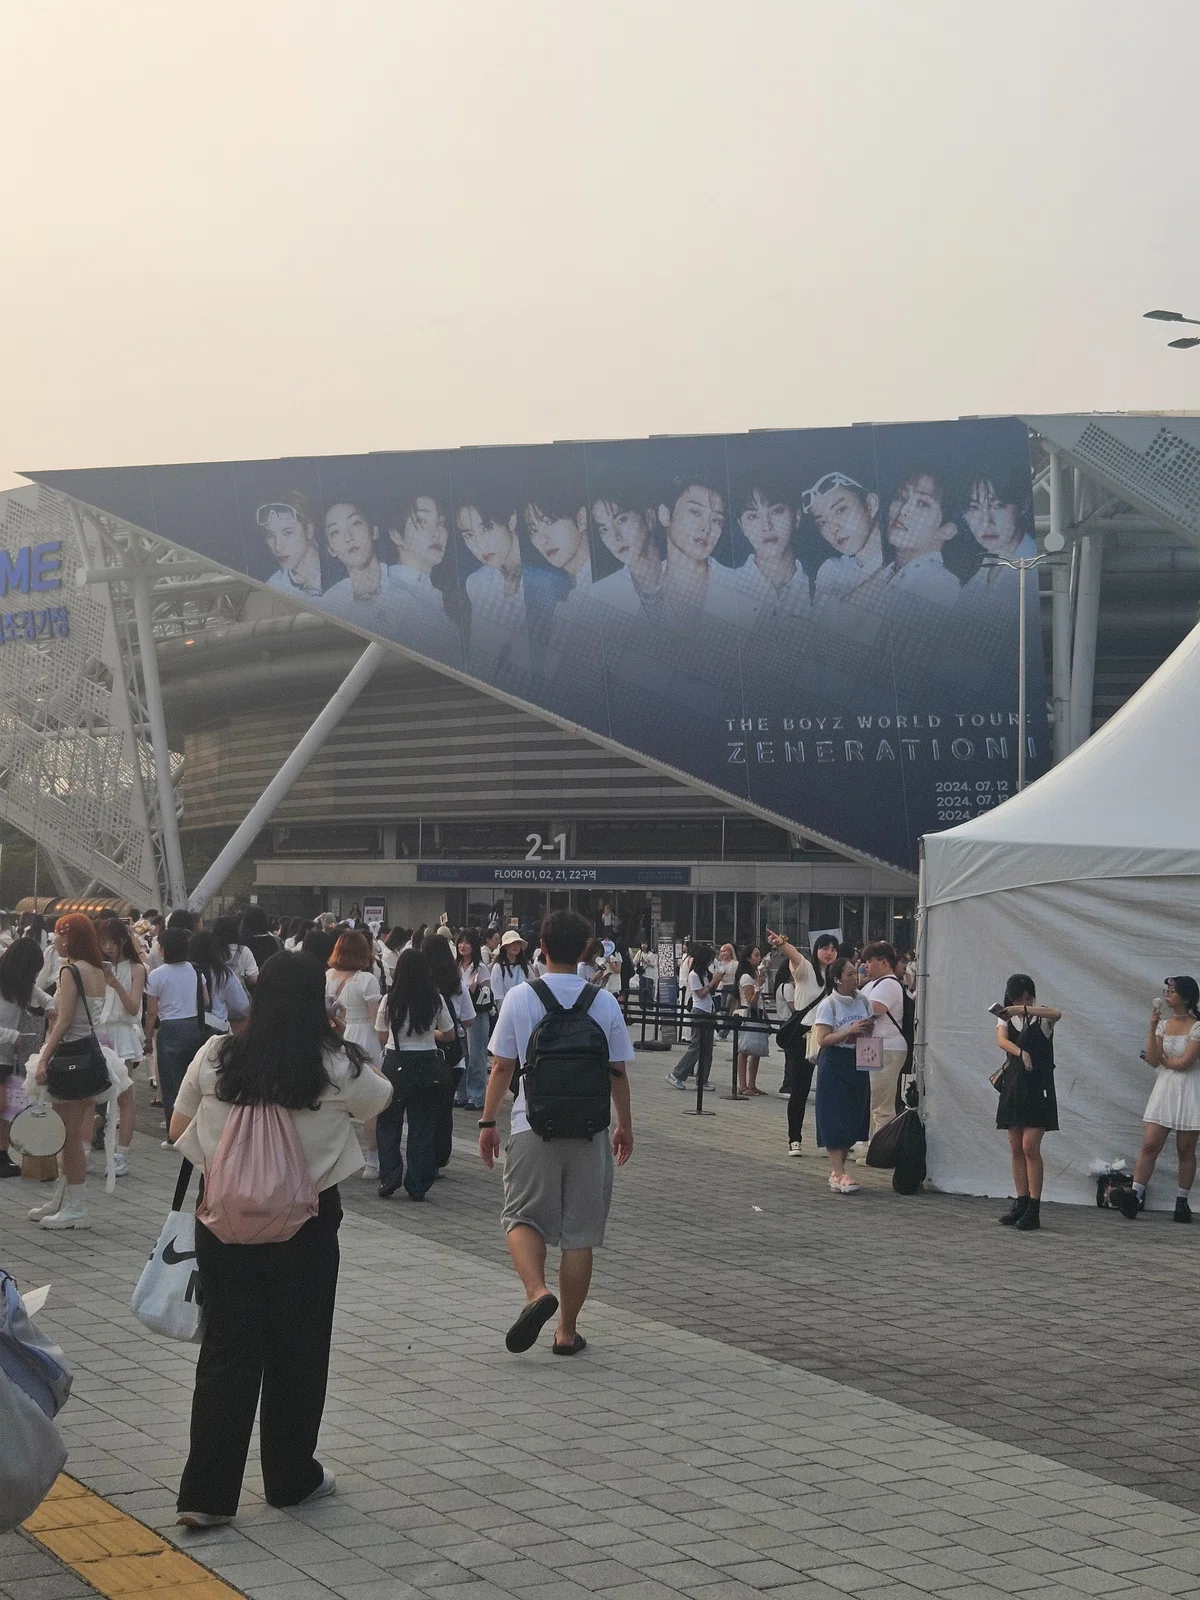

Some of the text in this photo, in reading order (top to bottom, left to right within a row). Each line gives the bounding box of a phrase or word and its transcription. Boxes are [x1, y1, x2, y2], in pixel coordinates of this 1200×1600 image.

[0, 606, 69, 646] 조경기장
[725, 717, 769, 731] THE
[782, 716, 844, 731] BOYZ
[856, 714, 942, 729] WORLD
[727, 737, 1008, 764] ZENERATION
[935, 782, 972, 792] 2024.
[975, 781, 994, 791] 07.
[996, 780, 1009, 791] 12
[936, 796, 972, 807] 2024.
[976, 795, 995, 805] 07.
[524, 833, 567, 861] 2-1
[494, 869, 523, 879] FLOOR
[555, 870, 567, 881] Z1,
[569, 869, 597, 881] Z2구역
